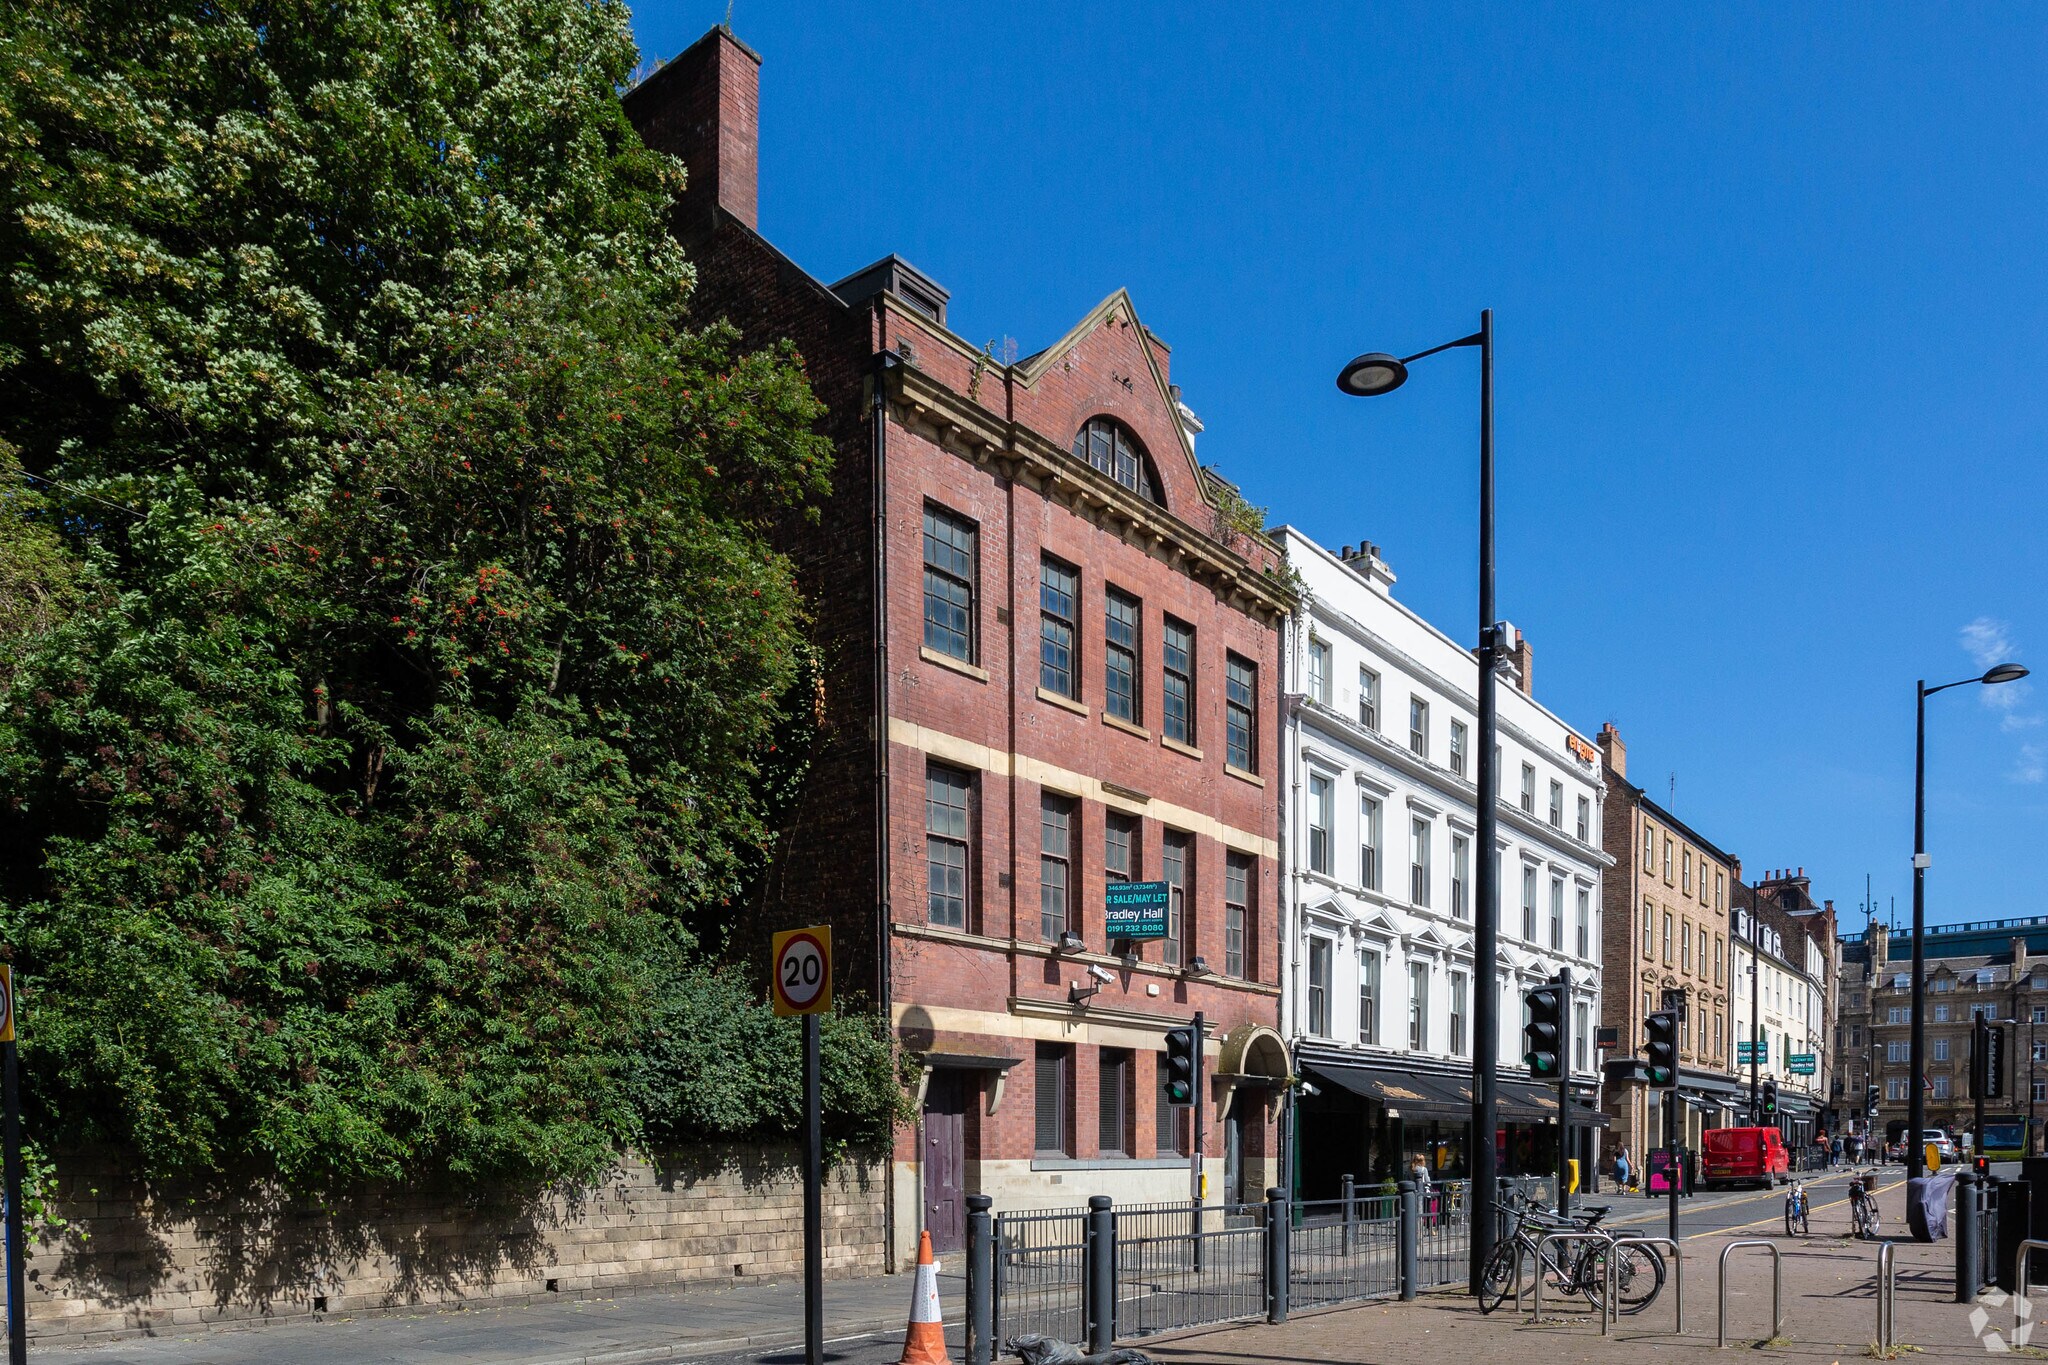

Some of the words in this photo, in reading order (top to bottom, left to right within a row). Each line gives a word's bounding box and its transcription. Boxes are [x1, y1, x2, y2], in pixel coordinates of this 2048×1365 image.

[1106, 895, 1112, 904] R
[1113, 893, 1151, 904] SALE/MAY
[1152, 893, 1167, 903] LET
[1104, 909, 1140, 922] Bradley
[1143, 908, 1163, 919] Hall
[784, 954, 820, 987] 20
